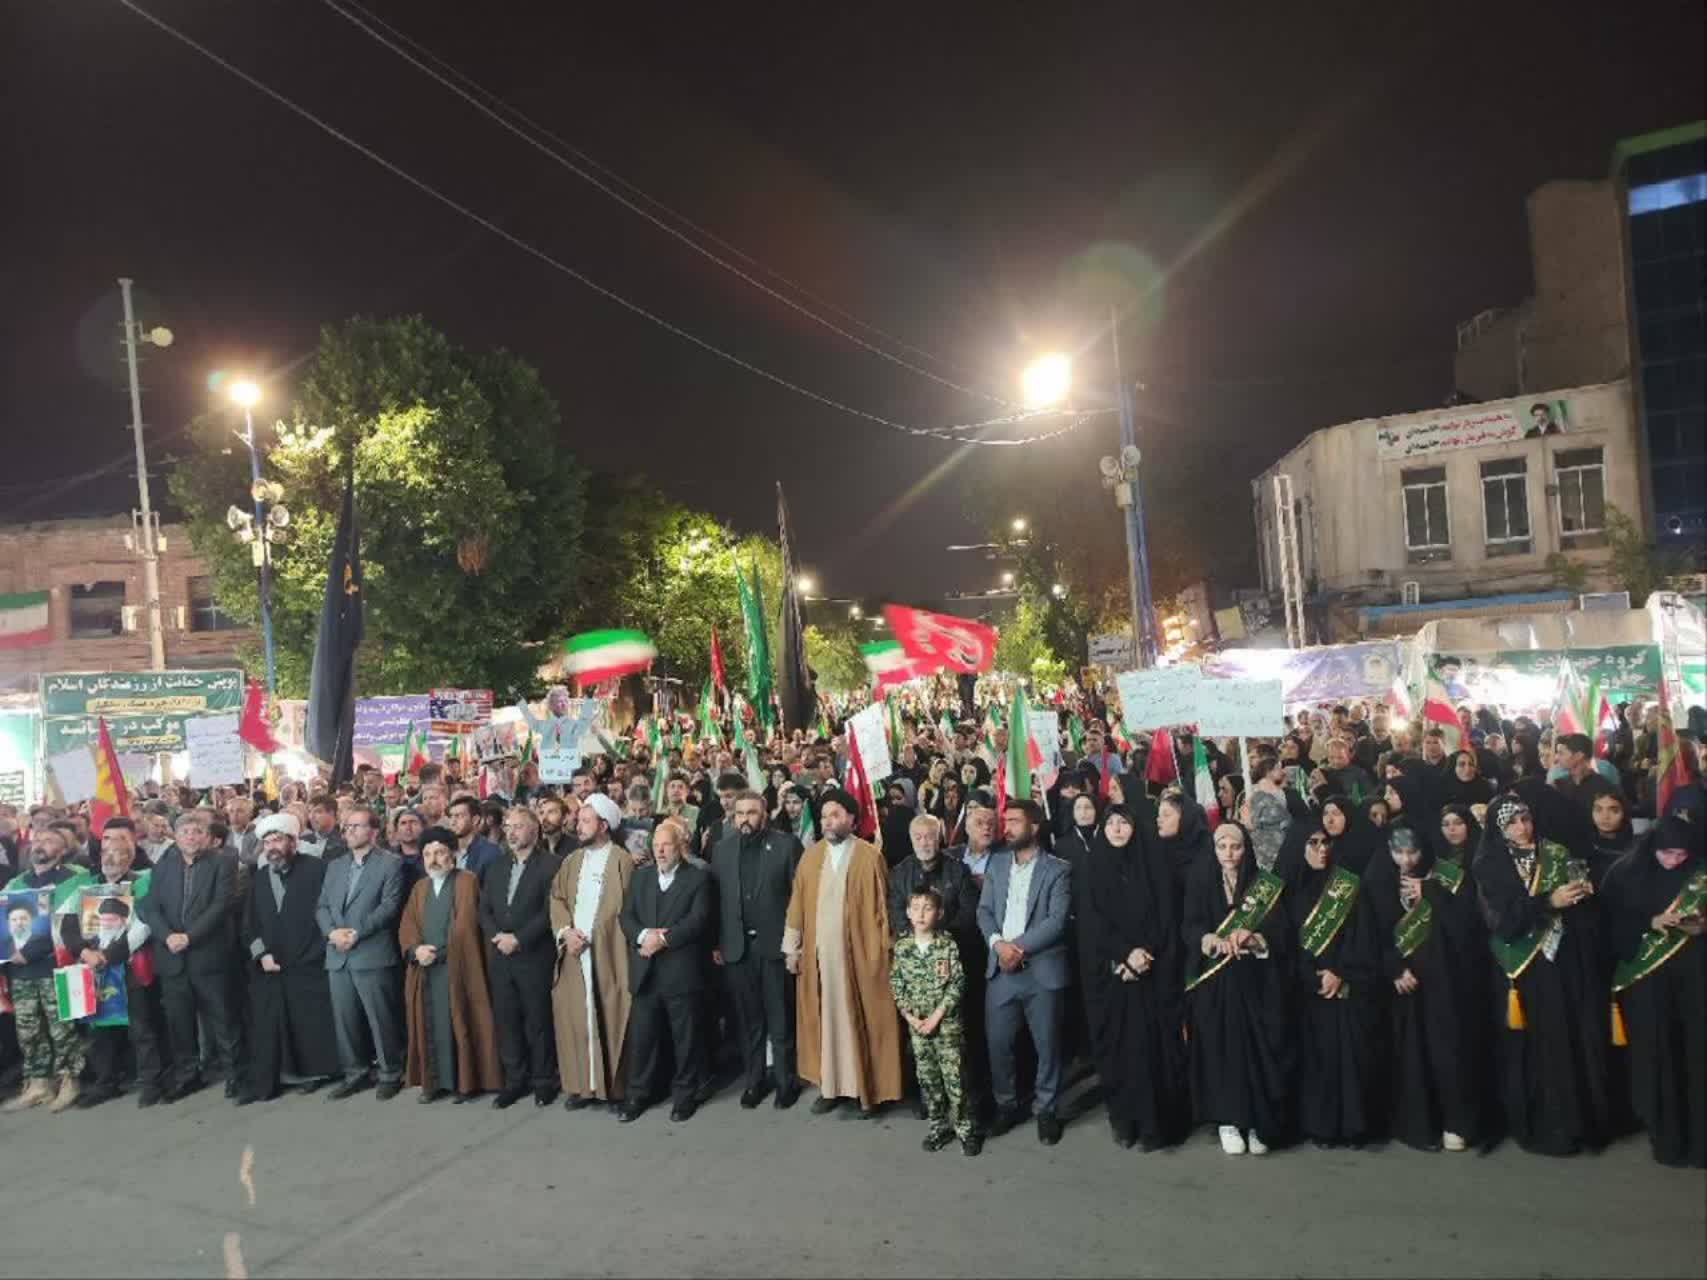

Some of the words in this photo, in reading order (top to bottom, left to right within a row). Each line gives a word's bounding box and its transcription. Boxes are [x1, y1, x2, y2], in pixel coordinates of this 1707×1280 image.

[1605, 650, 1648, 670] گروه
[48, 678, 83, 695] اسلام
[87, 677, 147, 694] رزمندگان
[151, 677, 163, 692] از
[165, 675, 204, 689] حمایت
[141, 715, 181, 736] موکب
